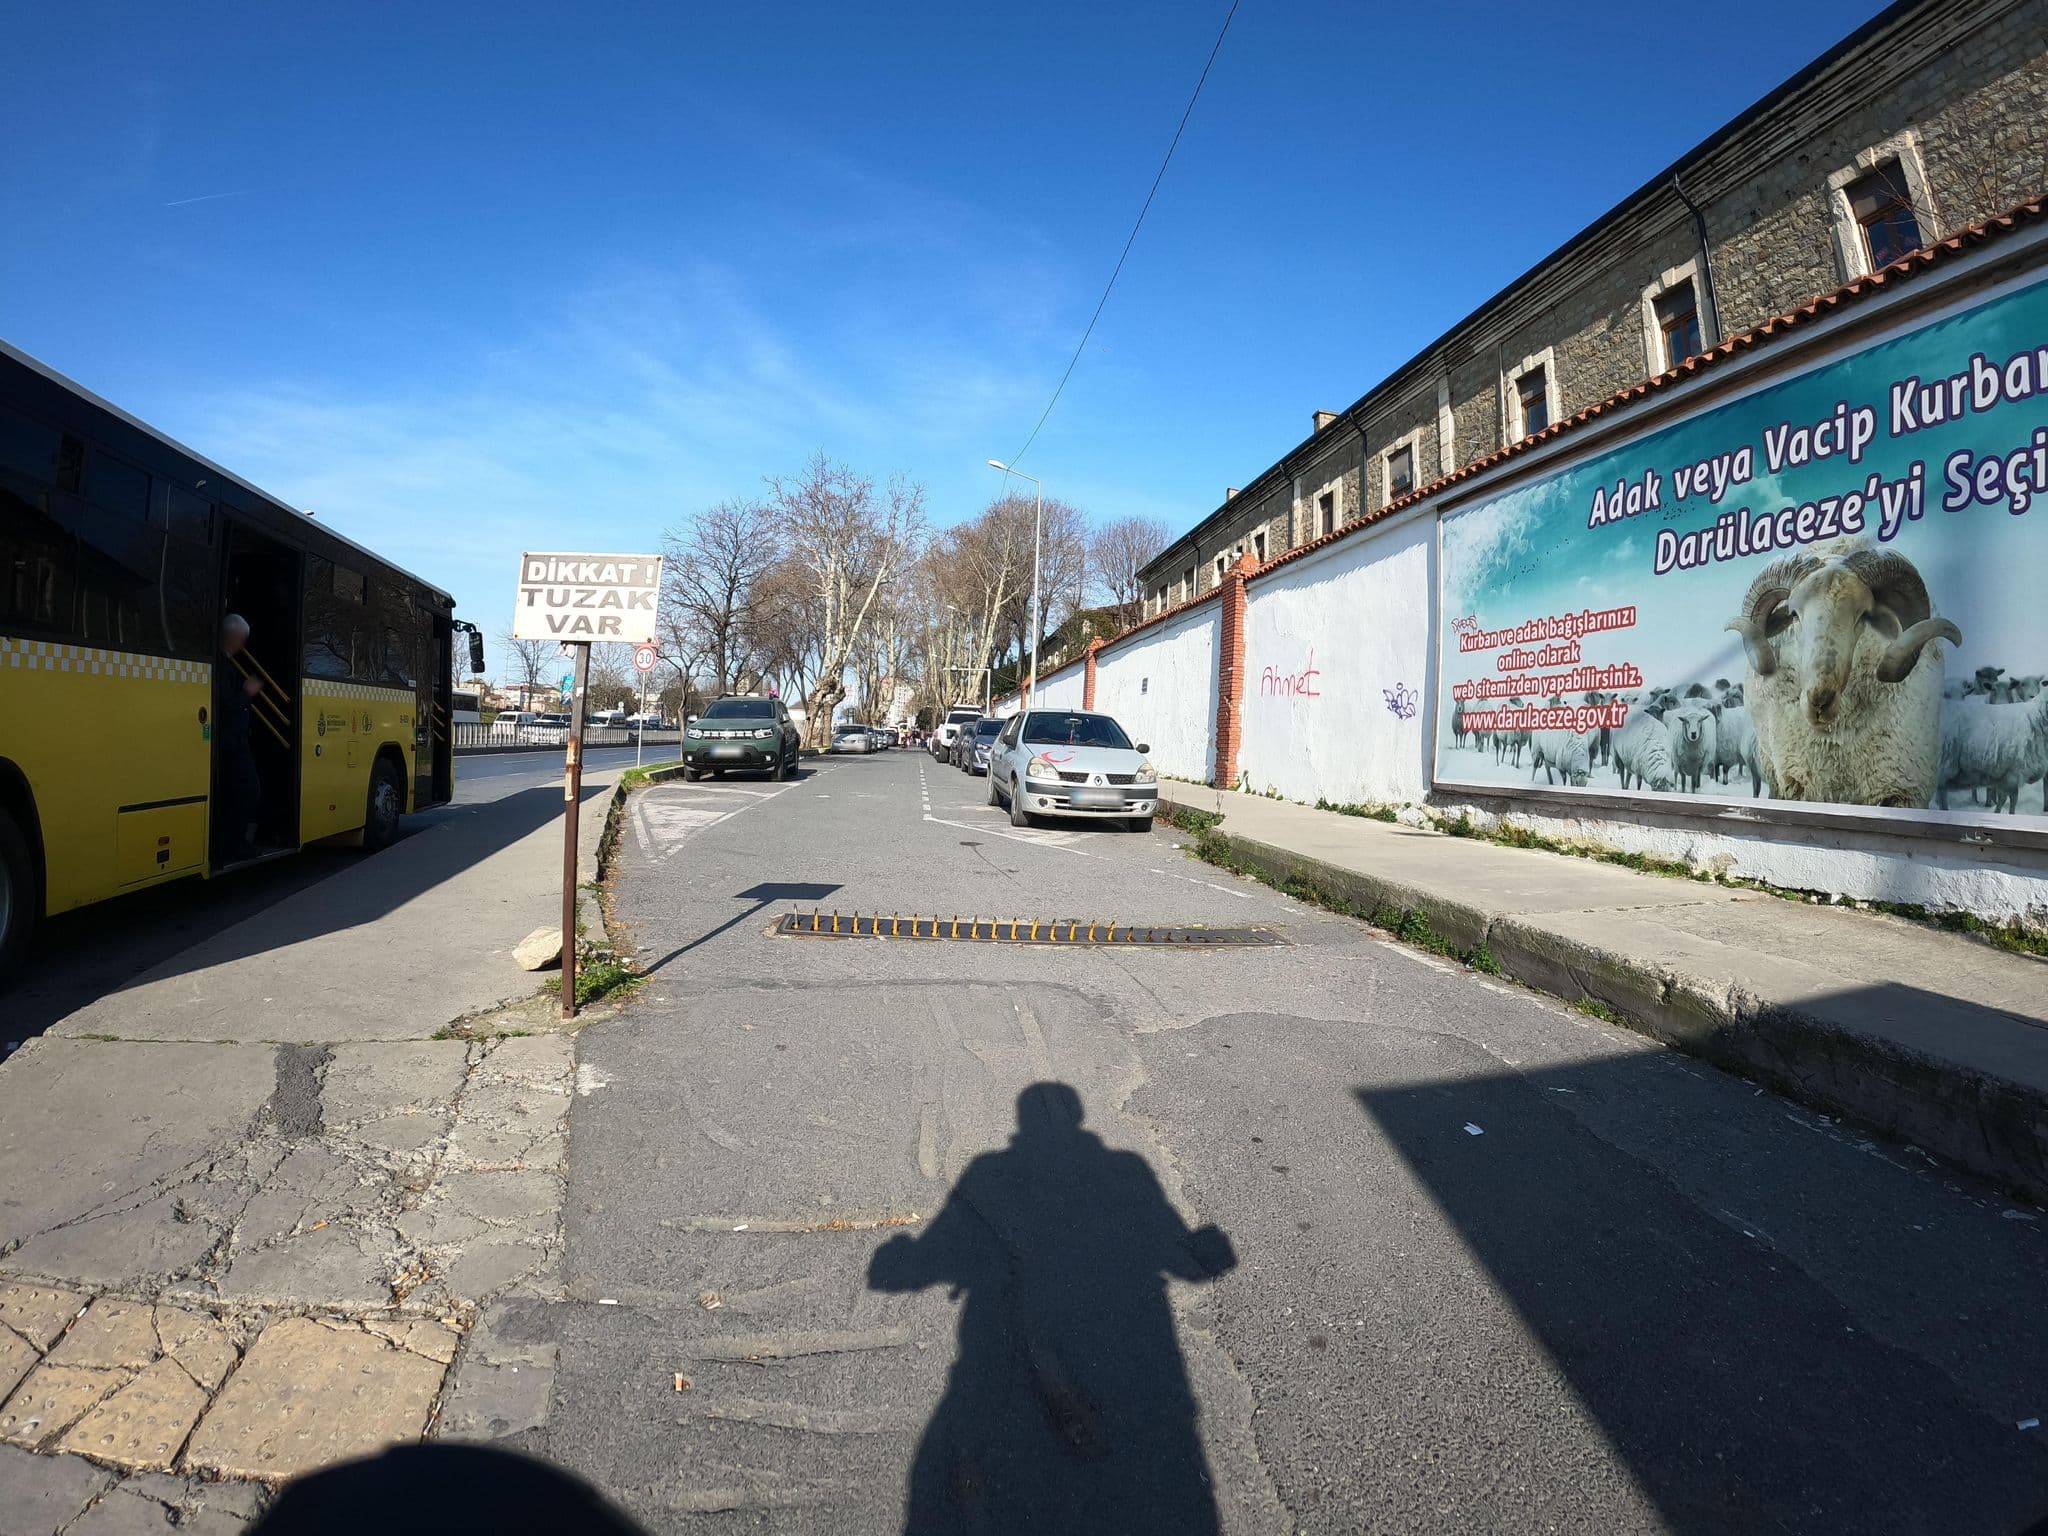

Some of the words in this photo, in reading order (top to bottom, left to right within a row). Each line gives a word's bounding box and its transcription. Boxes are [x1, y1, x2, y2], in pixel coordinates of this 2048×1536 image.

[1589, 469, 1661, 527] Adak
[1673, 446, 1752, 502] veya
[1764, 401, 1877, 463] Vacip
[1654, 460, 1926, 575] Darülaceze'yi
[527, 557, 637, 583] DİKKAT
[645, 564, 655, 584] !
[521, 588, 654, 610] TUZAK
[545, 614, 622, 635] VAR
[1460, 629, 1498, 652] Kurban
[1500, 631, 1514, 646] ve
[1515, 619, 1547, 643] adak
[1549, 606, 1636, 639] bağışlarınızı
[638, 652, 651, 665] 30
[1497, 648, 1535, 672] online
[1537, 640, 1581, 667] olarak
[1453, 679, 1475, 699] web
[1476, 674, 1539, 699] sitemizden
[1540, 662, 1643, 697] yapabilirsiniz.
[1462, 702, 1629, 734] www.darulaceze.gov.tr
